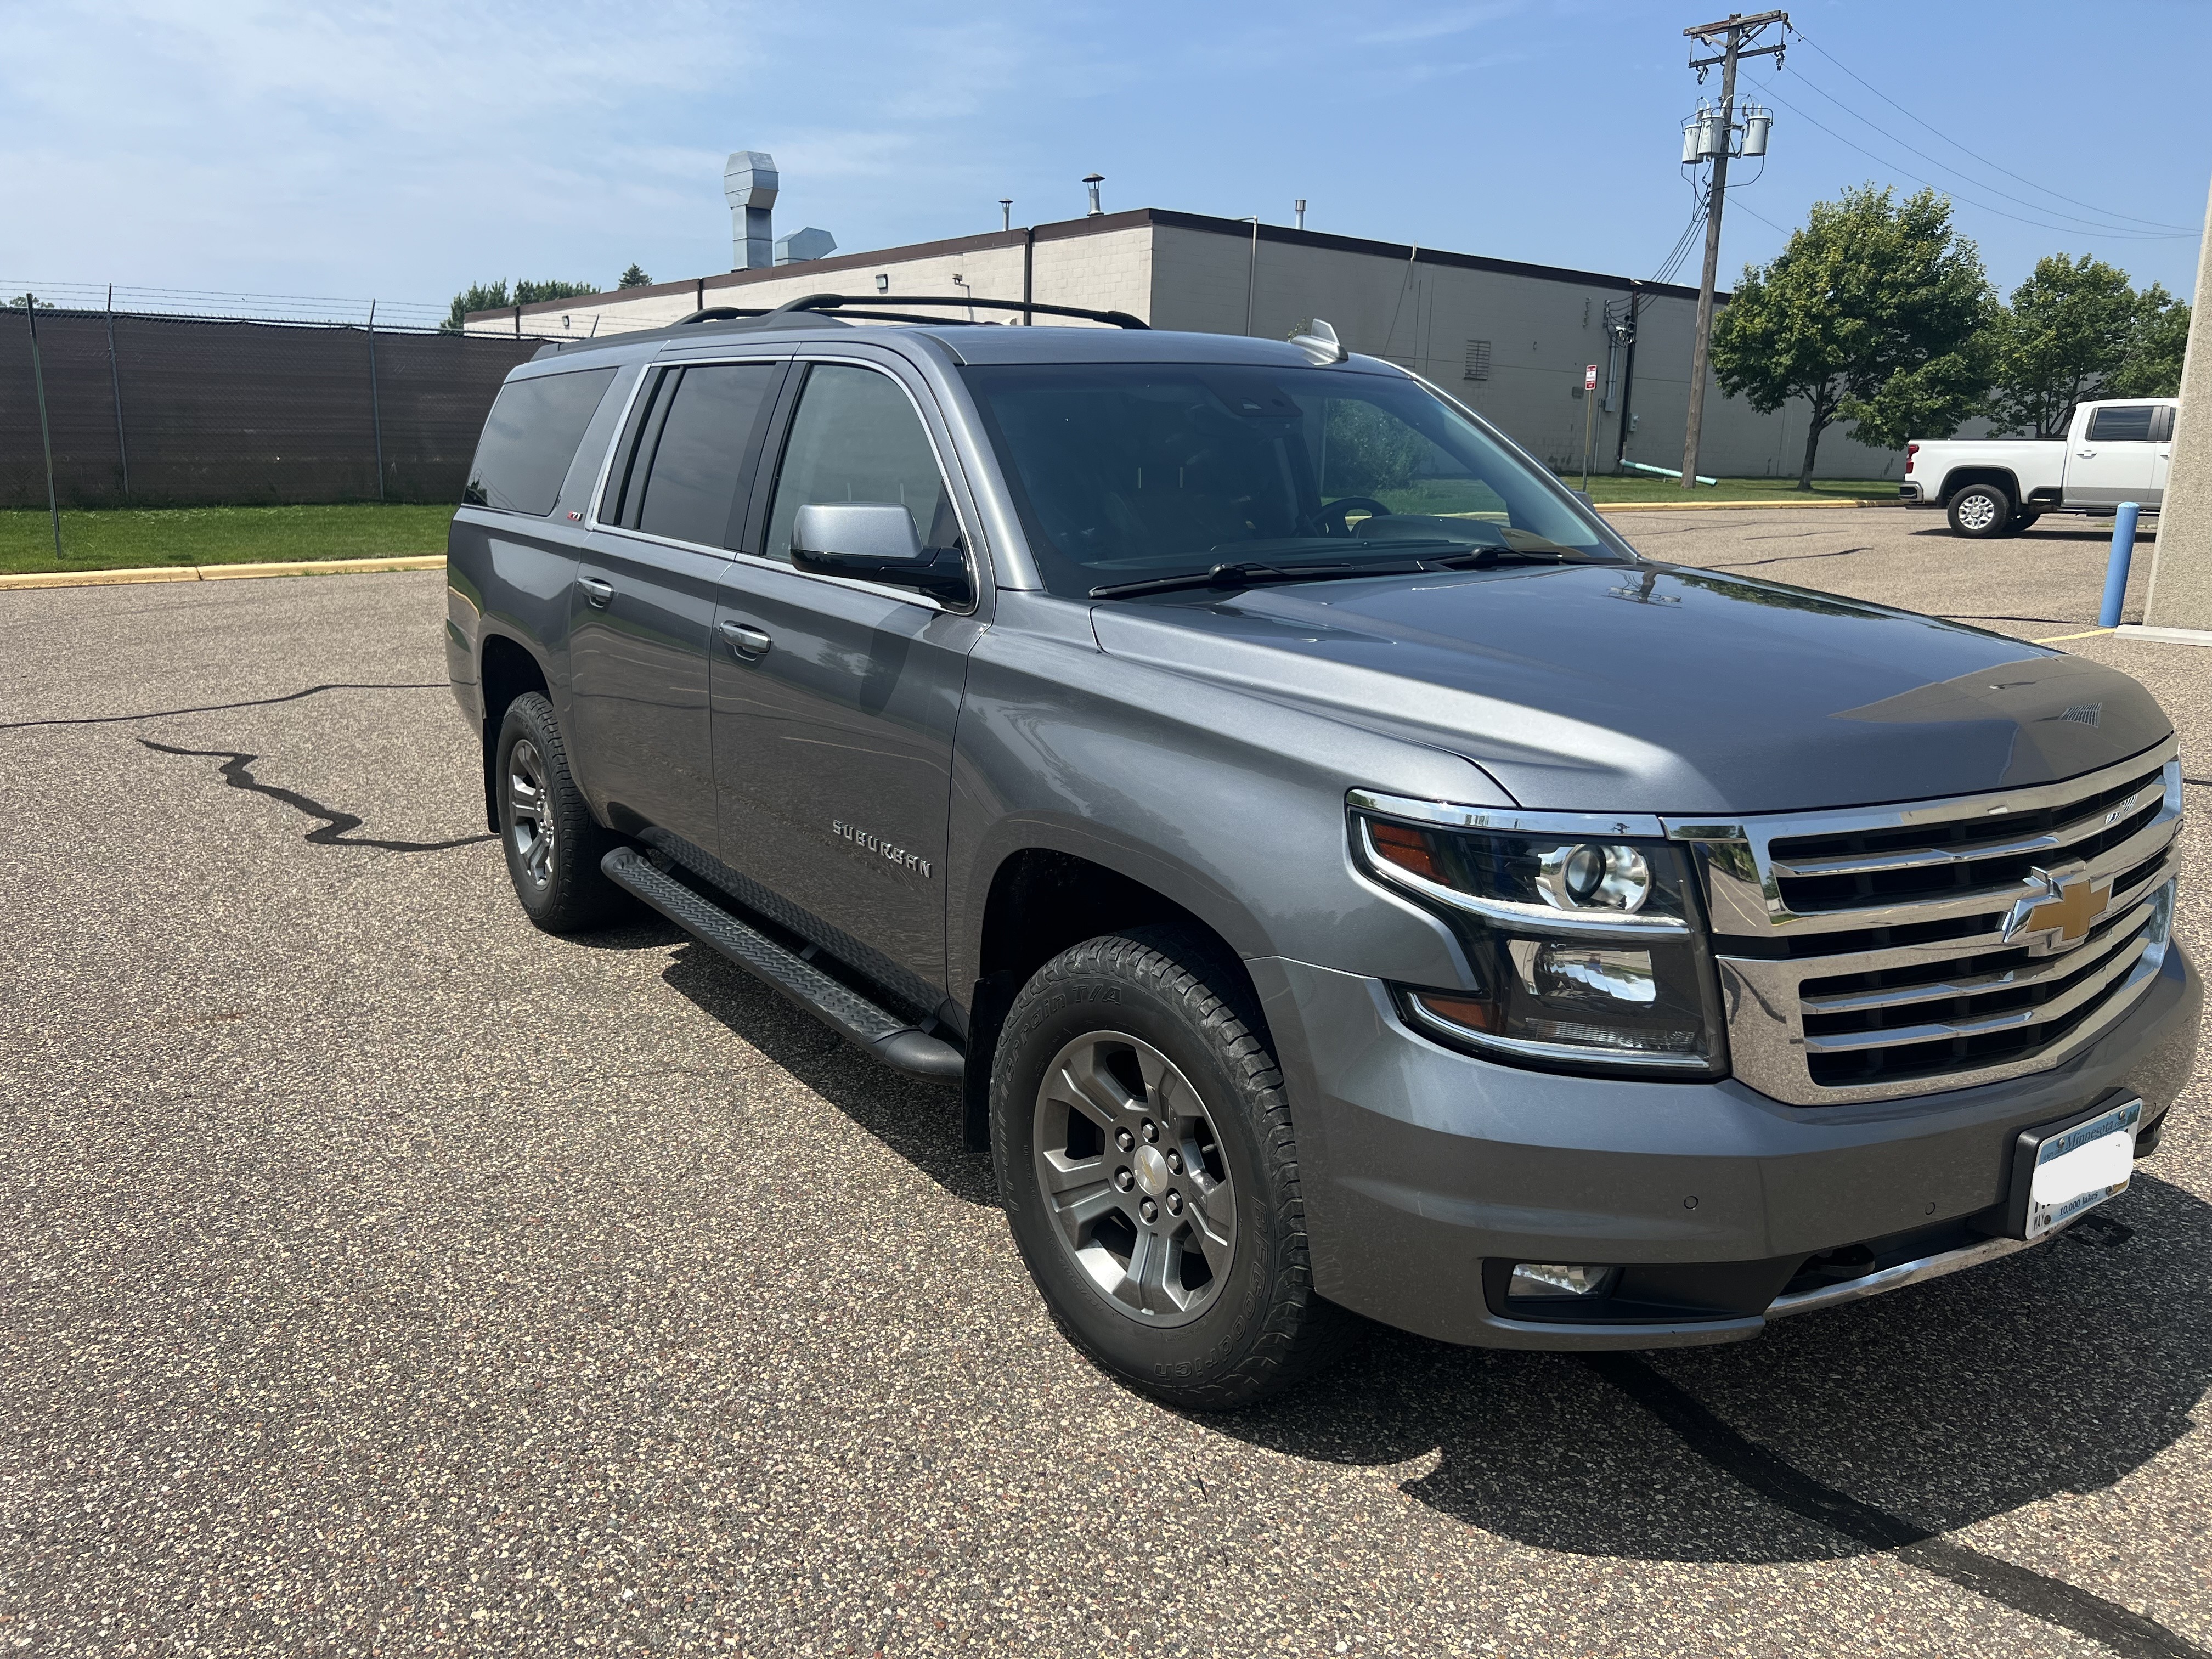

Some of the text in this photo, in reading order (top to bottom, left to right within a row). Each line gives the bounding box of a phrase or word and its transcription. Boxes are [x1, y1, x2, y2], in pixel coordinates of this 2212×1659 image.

[567, 511, 582, 521] Z71
[833, 820, 932, 878] SUBURBAN
[1073, 984, 1121, 1005] T/A
[2059, 1199, 2081, 1216] 10,000
[2082, 1191, 2098, 1205] lakes
[2033, 1211, 2045, 1231] MAY
[1154, 1195, 1269, 1381] BFGoodrich
